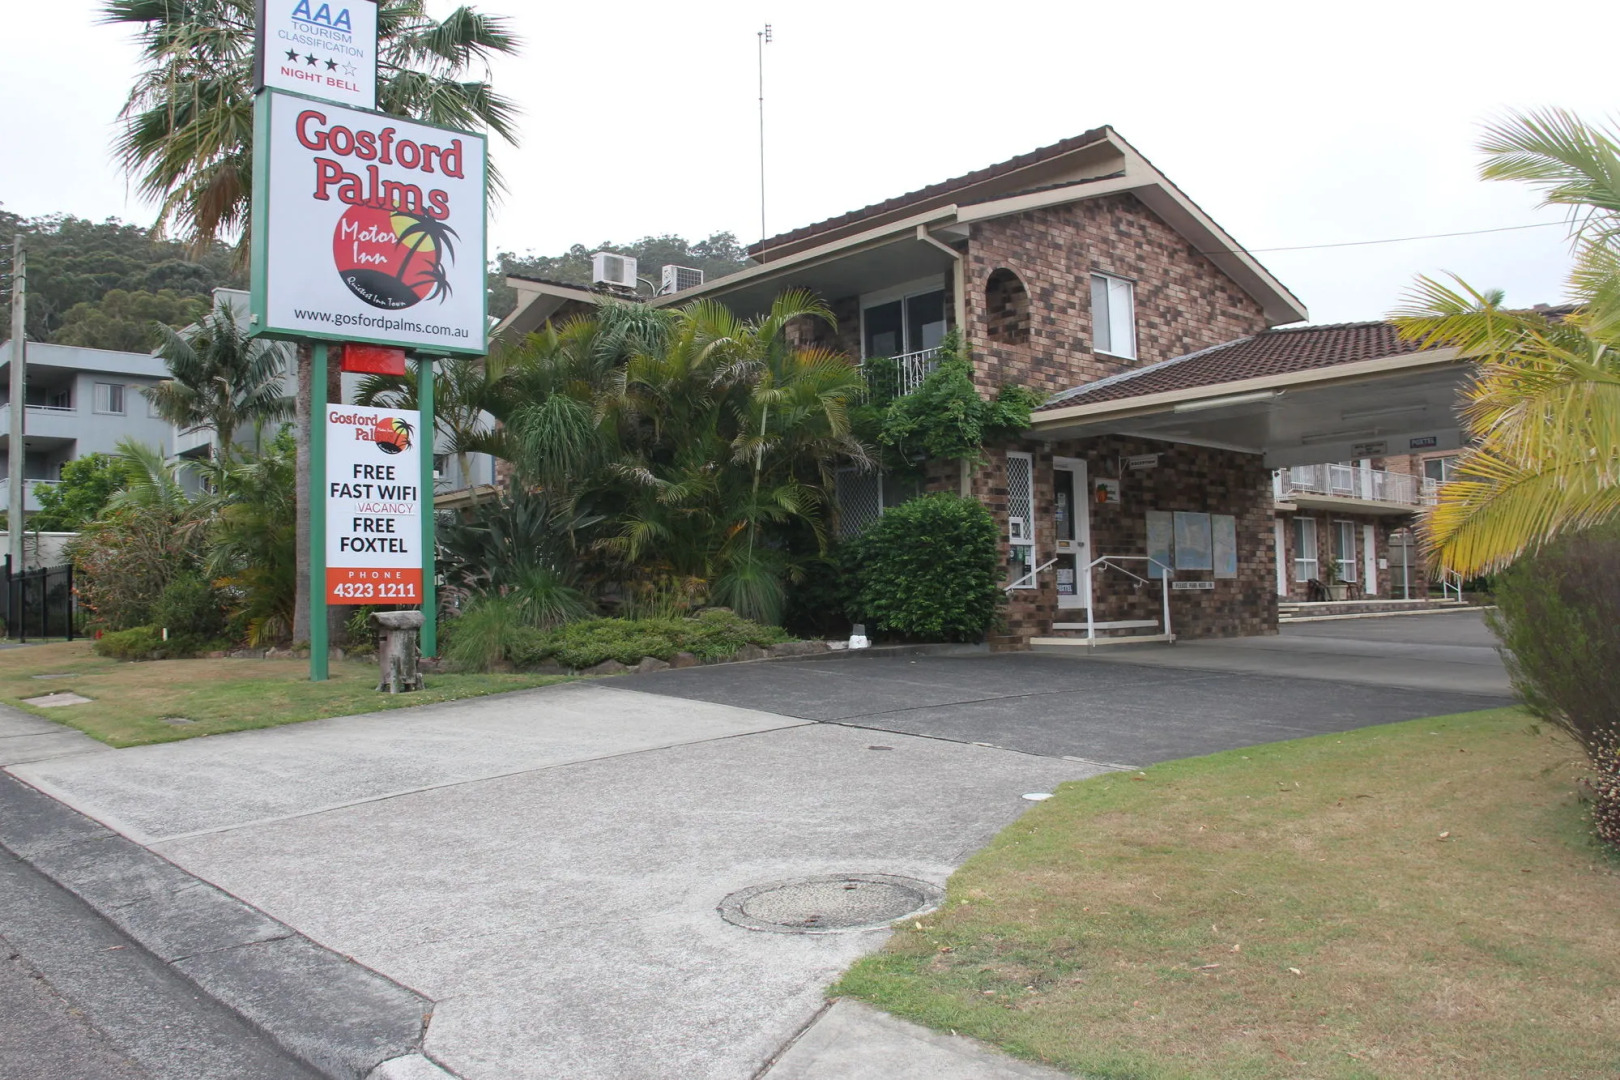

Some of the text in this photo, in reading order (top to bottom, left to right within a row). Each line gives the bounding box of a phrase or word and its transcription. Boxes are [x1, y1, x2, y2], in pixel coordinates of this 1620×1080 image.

[292, 0, 352, 30] AAA
[278, 29, 364, 58] CLASSIFICATION
[291, 21, 352, 44] TOURISM
[281, 66, 361, 92] NIGHT BELL
[296, 110, 465, 179] Gosford
[313, 157, 450, 220] Palms
[341, 218, 399, 243] Motor
[353, 242, 388, 265] Inn
[294, 309, 470, 338] www.gosfordpalms.com.au
[329, 411, 378, 426] Gosford
[353, 464, 396, 481] FREE
[331, 483, 417, 501] FAST WIFI
[357, 502, 414, 514] VACANCY
[353, 517, 396, 533] FREE
[340, 537, 408, 553] FOXTEL
[348, 571, 402, 579] PHONE
[333, 583, 416, 598] 4323 1211
